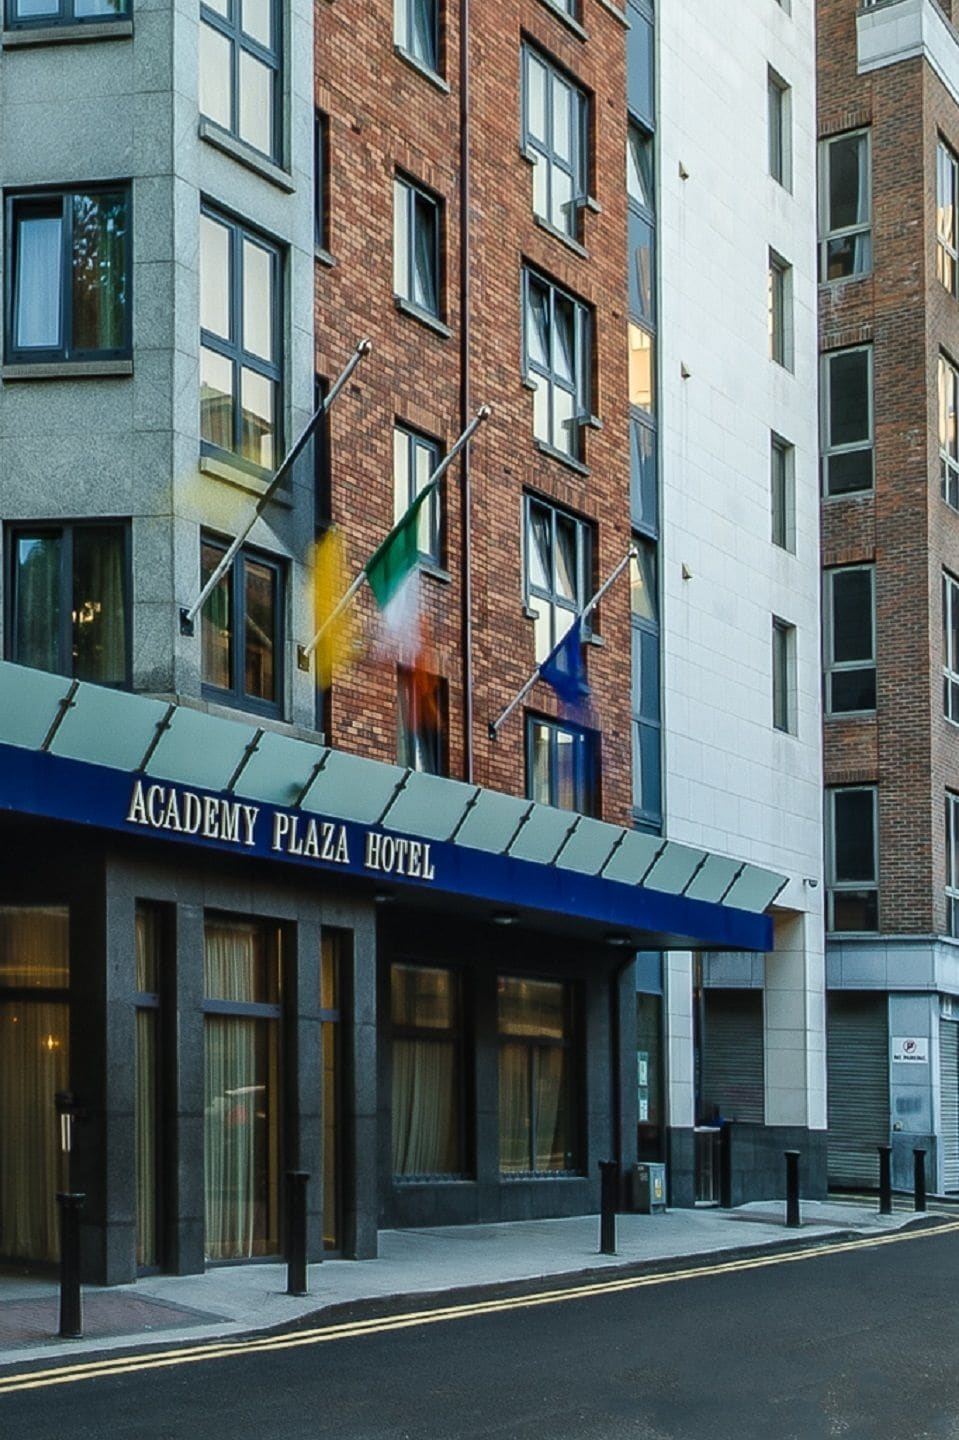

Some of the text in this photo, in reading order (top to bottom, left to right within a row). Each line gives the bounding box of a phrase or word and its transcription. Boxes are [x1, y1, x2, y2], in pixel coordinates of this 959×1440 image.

[126, 779, 435, 880] ACADEMY PLAZA HOTEL
